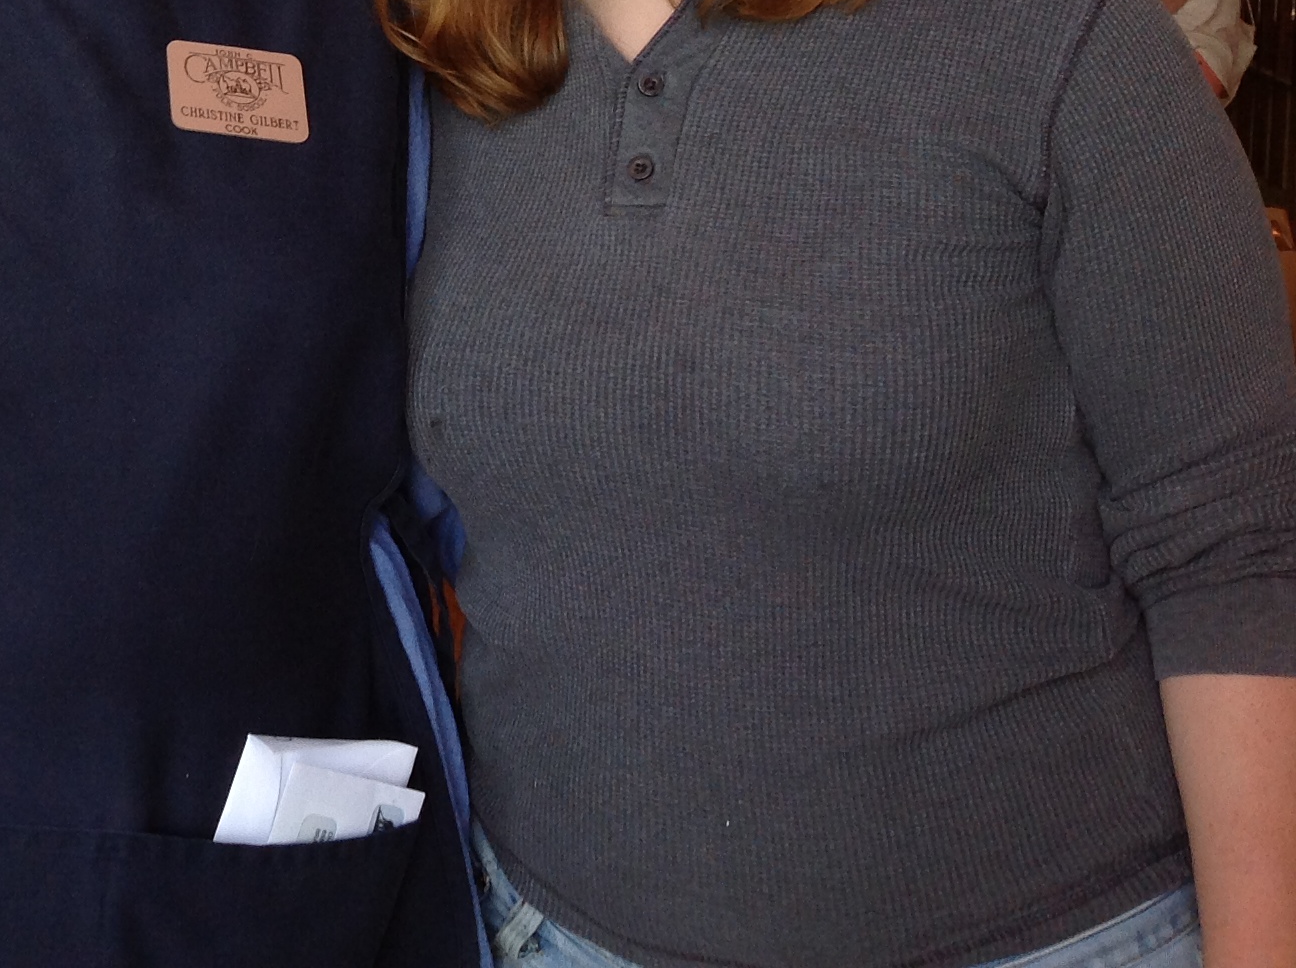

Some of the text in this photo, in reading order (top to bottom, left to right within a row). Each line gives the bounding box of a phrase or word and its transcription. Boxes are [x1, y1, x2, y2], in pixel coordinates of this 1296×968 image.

[215, 48, 240, 58] JOHN
[180, 106, 299, 130] CHRISTINE GILBERT
[225, 124, 259, 135] COOK
